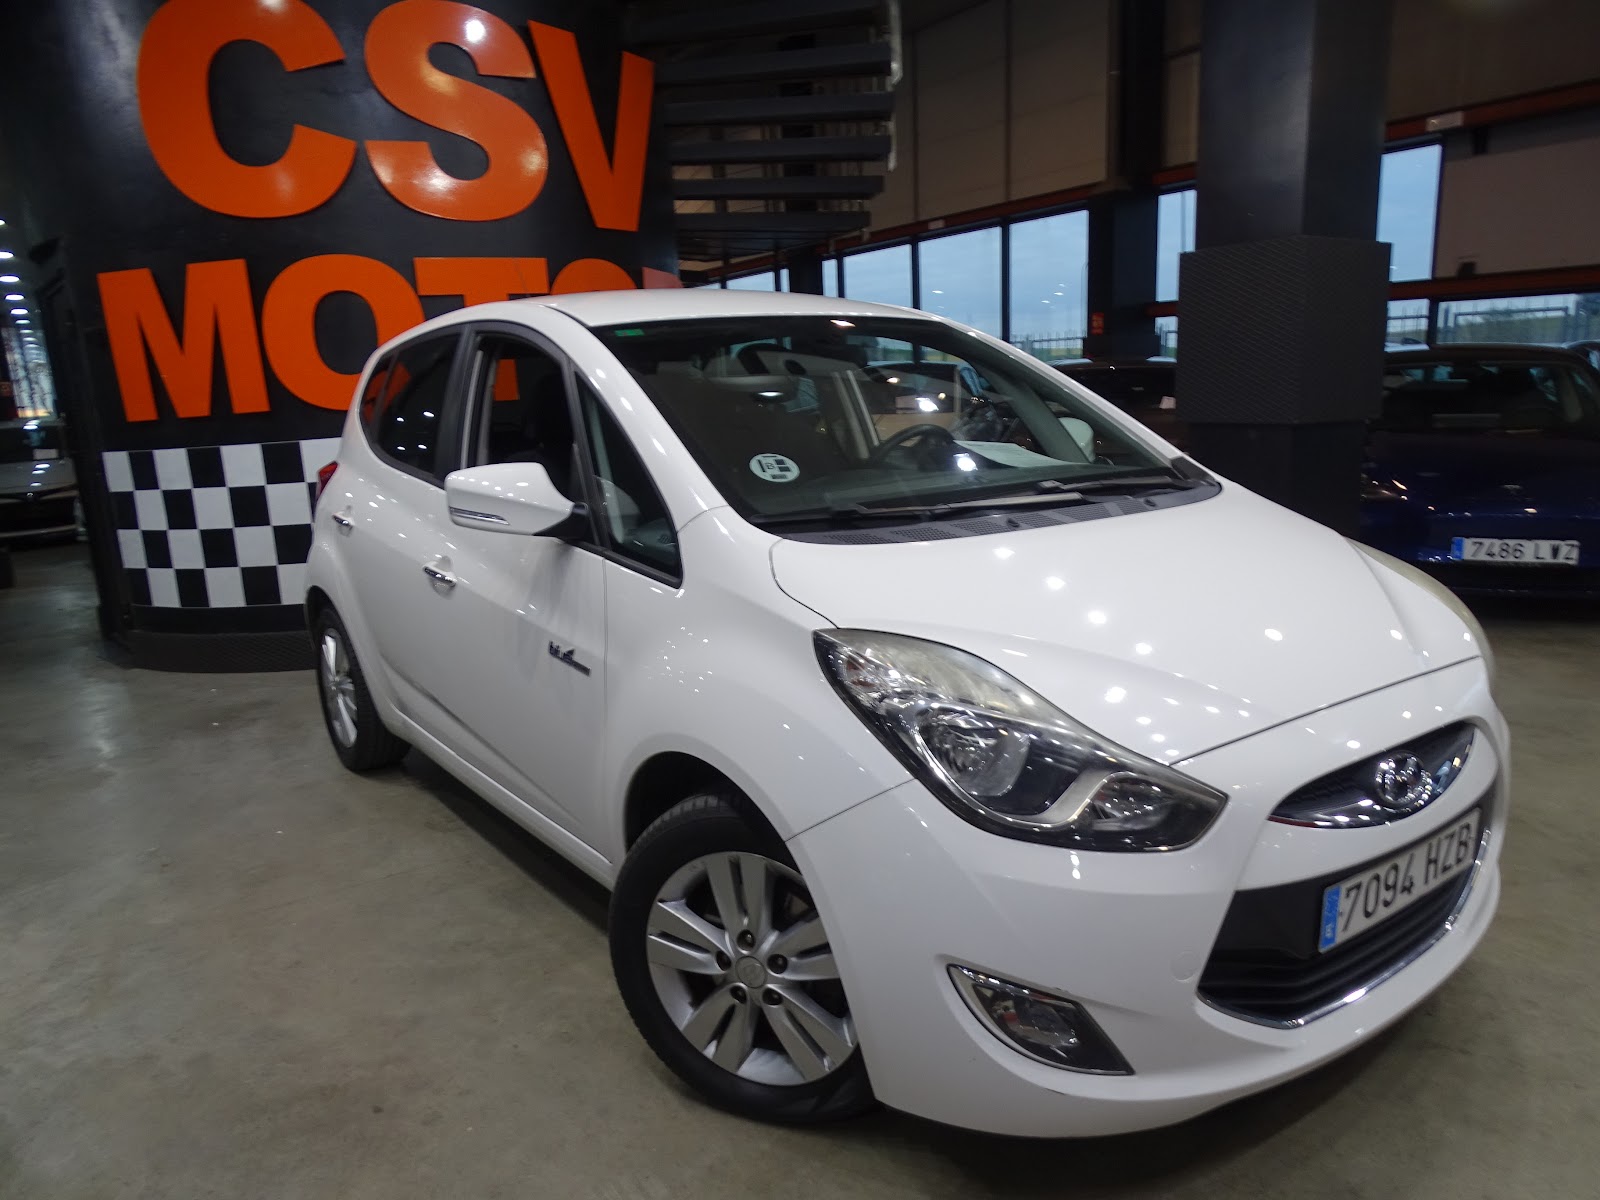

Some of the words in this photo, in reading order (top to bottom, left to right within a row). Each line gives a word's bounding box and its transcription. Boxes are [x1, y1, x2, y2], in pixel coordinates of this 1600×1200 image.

[137, 0, 654, 231] CSV
[97, 253, 681, 422] MOT
[1470, 541, 1525, 559] 7486
[1342, 852, 1415, 923] 7094
[1424, 822, 1471, 886] HZB
